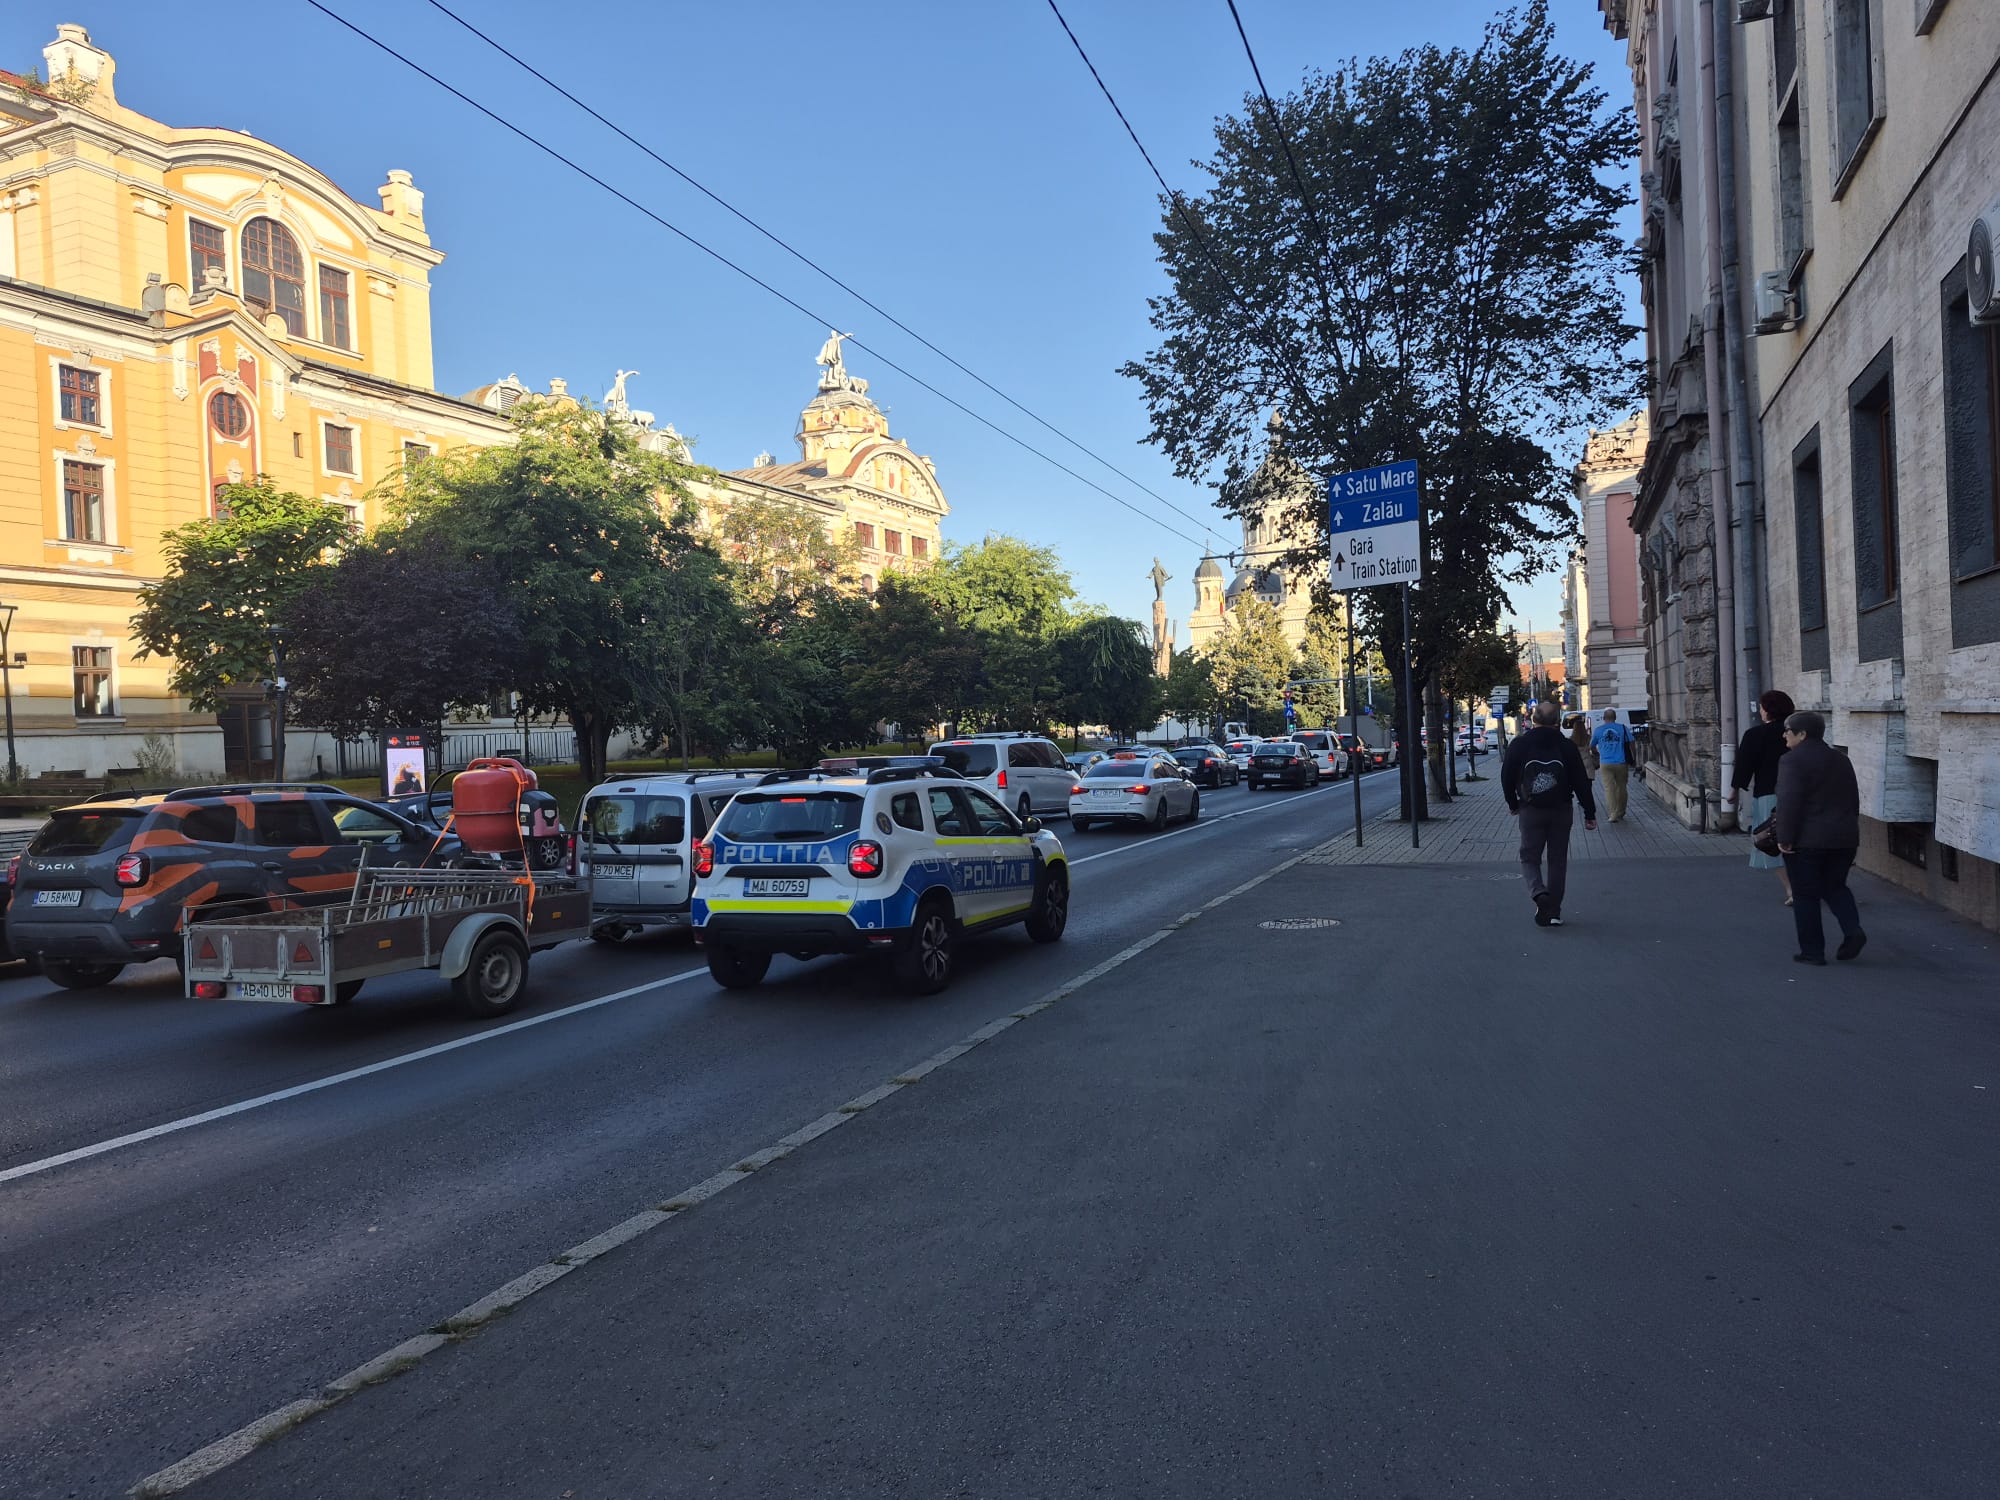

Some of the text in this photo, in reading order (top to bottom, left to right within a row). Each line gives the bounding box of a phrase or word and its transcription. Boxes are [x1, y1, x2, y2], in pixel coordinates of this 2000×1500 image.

[1346, 469, 1415, 496] Satu Mare
[1362, 501, 1403, 523] Zalău
[1350, 537, 1373, 556] Gară
[1351, 556, 1417, 580] Train Station
[723, 845, 834, 863] POLITIA
[38, 863, 76, 871] DACIA
[963, 863, 1017, 887] POLITIA
[751, 880, 805, 892] MAI 60759
